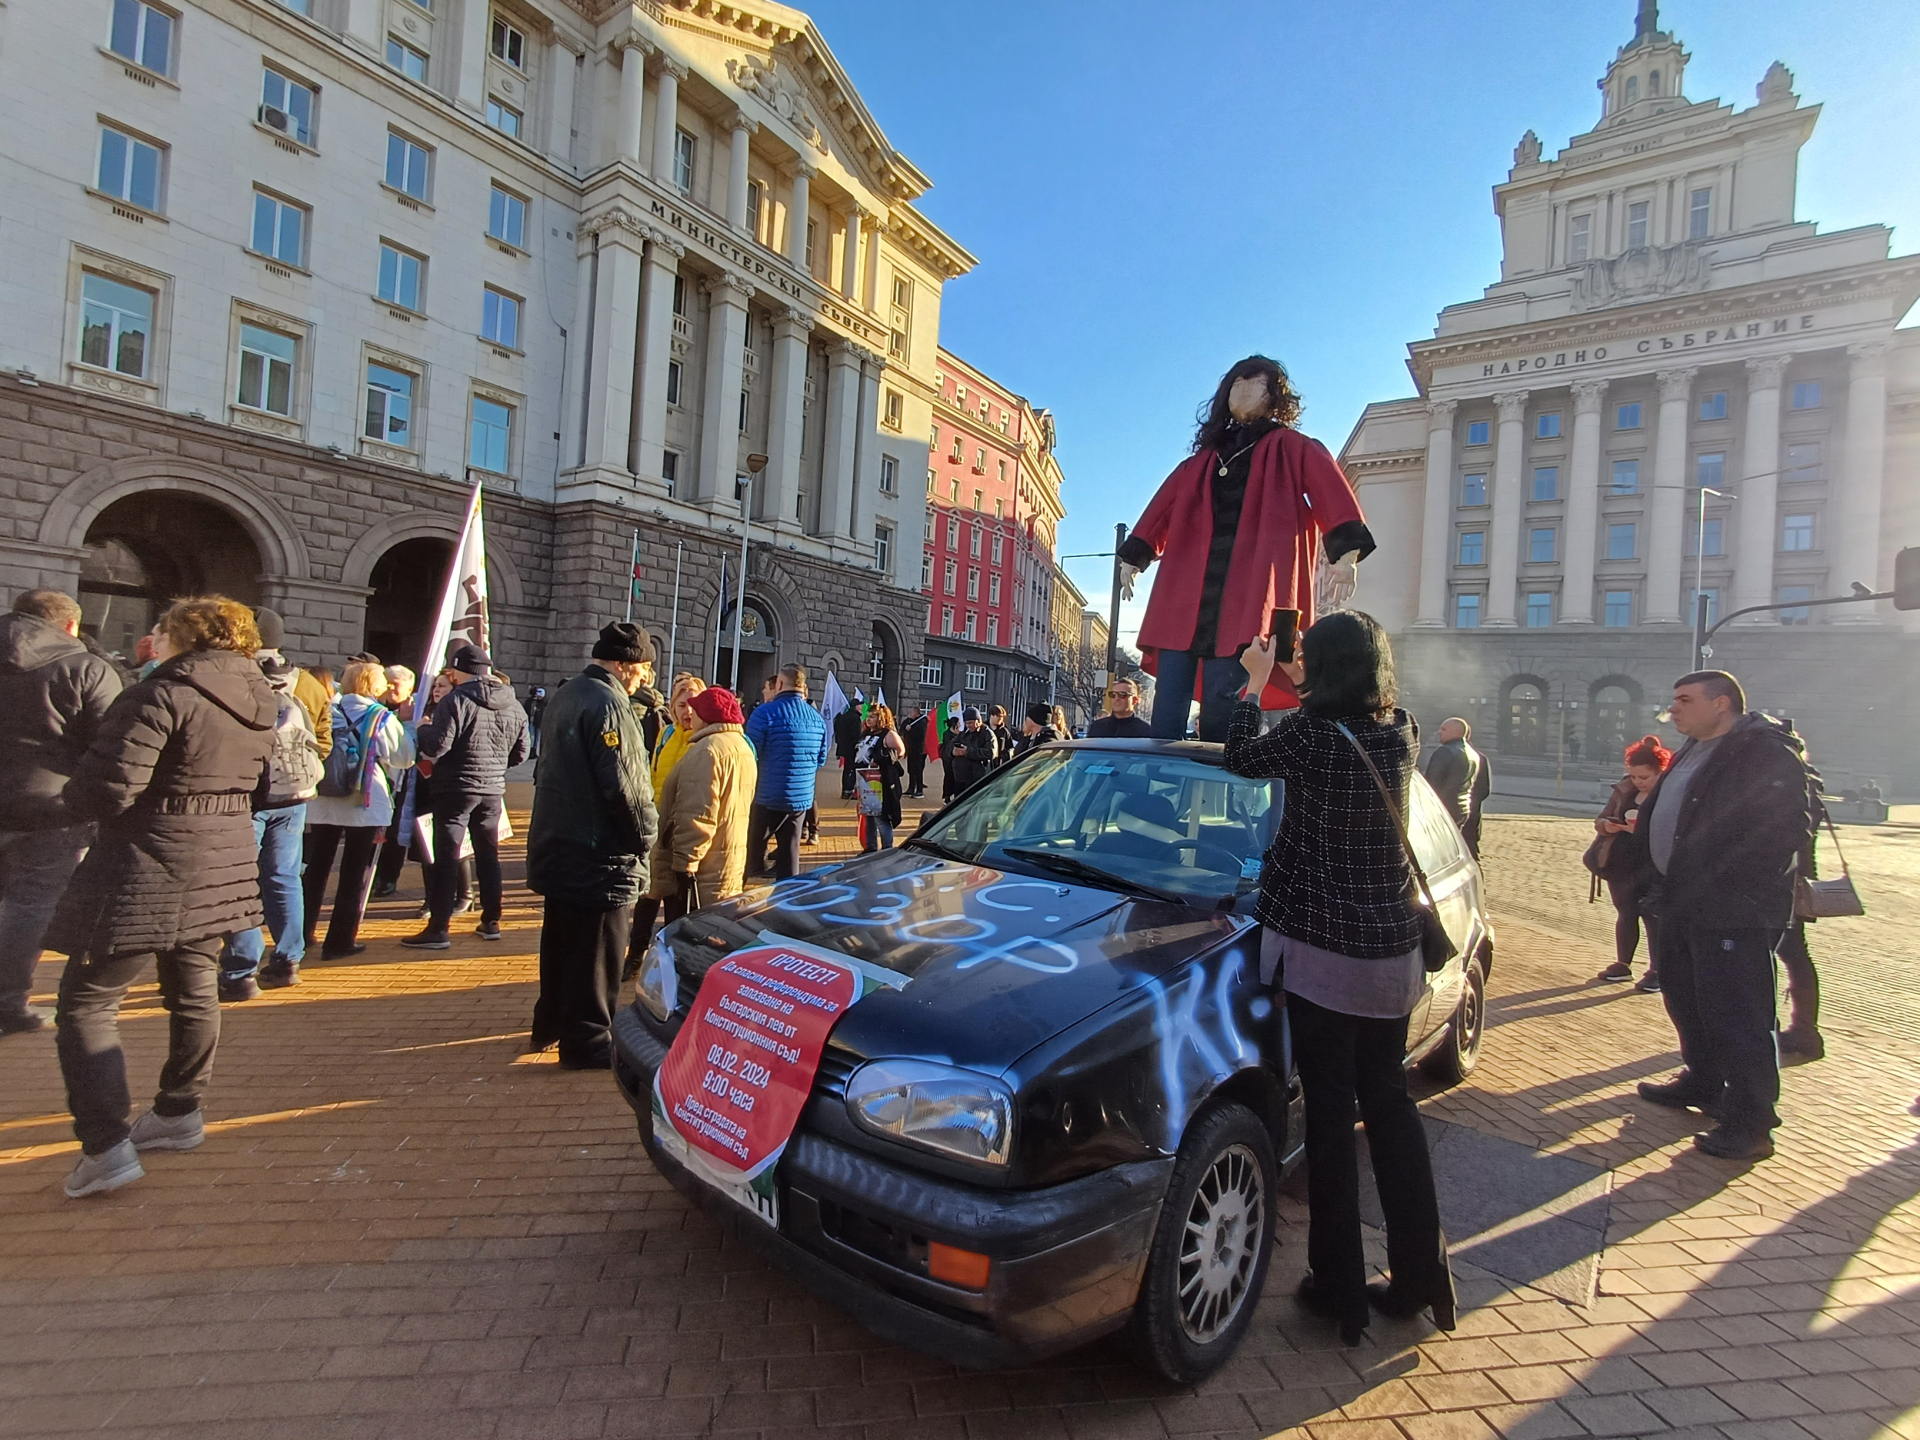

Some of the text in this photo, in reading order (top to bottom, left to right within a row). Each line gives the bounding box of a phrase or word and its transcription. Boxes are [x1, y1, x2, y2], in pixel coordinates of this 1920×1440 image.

[651, 200, 871, 338] МИНИСТЕРСКИ СЪВЕТ
[1483, 314, 1816, 377] НАРОДНО СЪБРАНИЕ
[721, 961, 839, 1013] Да спасим референдума за
[767, 953, 840, 985] ПРОТЕСТ!
[719, 994, 798, 1039] българския лев от
[737, 985, 795, 1015] запазване на
[704, 1007, 801, 1064] Конституционния съд!
[707, 1044, 771, 1089] 08.02. 2024
[702, 1069, 755, 1112] 9:00 часа
[673, 1102, 750, 1161] Конституционния съд
[684, 1094, 747, 1140] Пред сградата на
